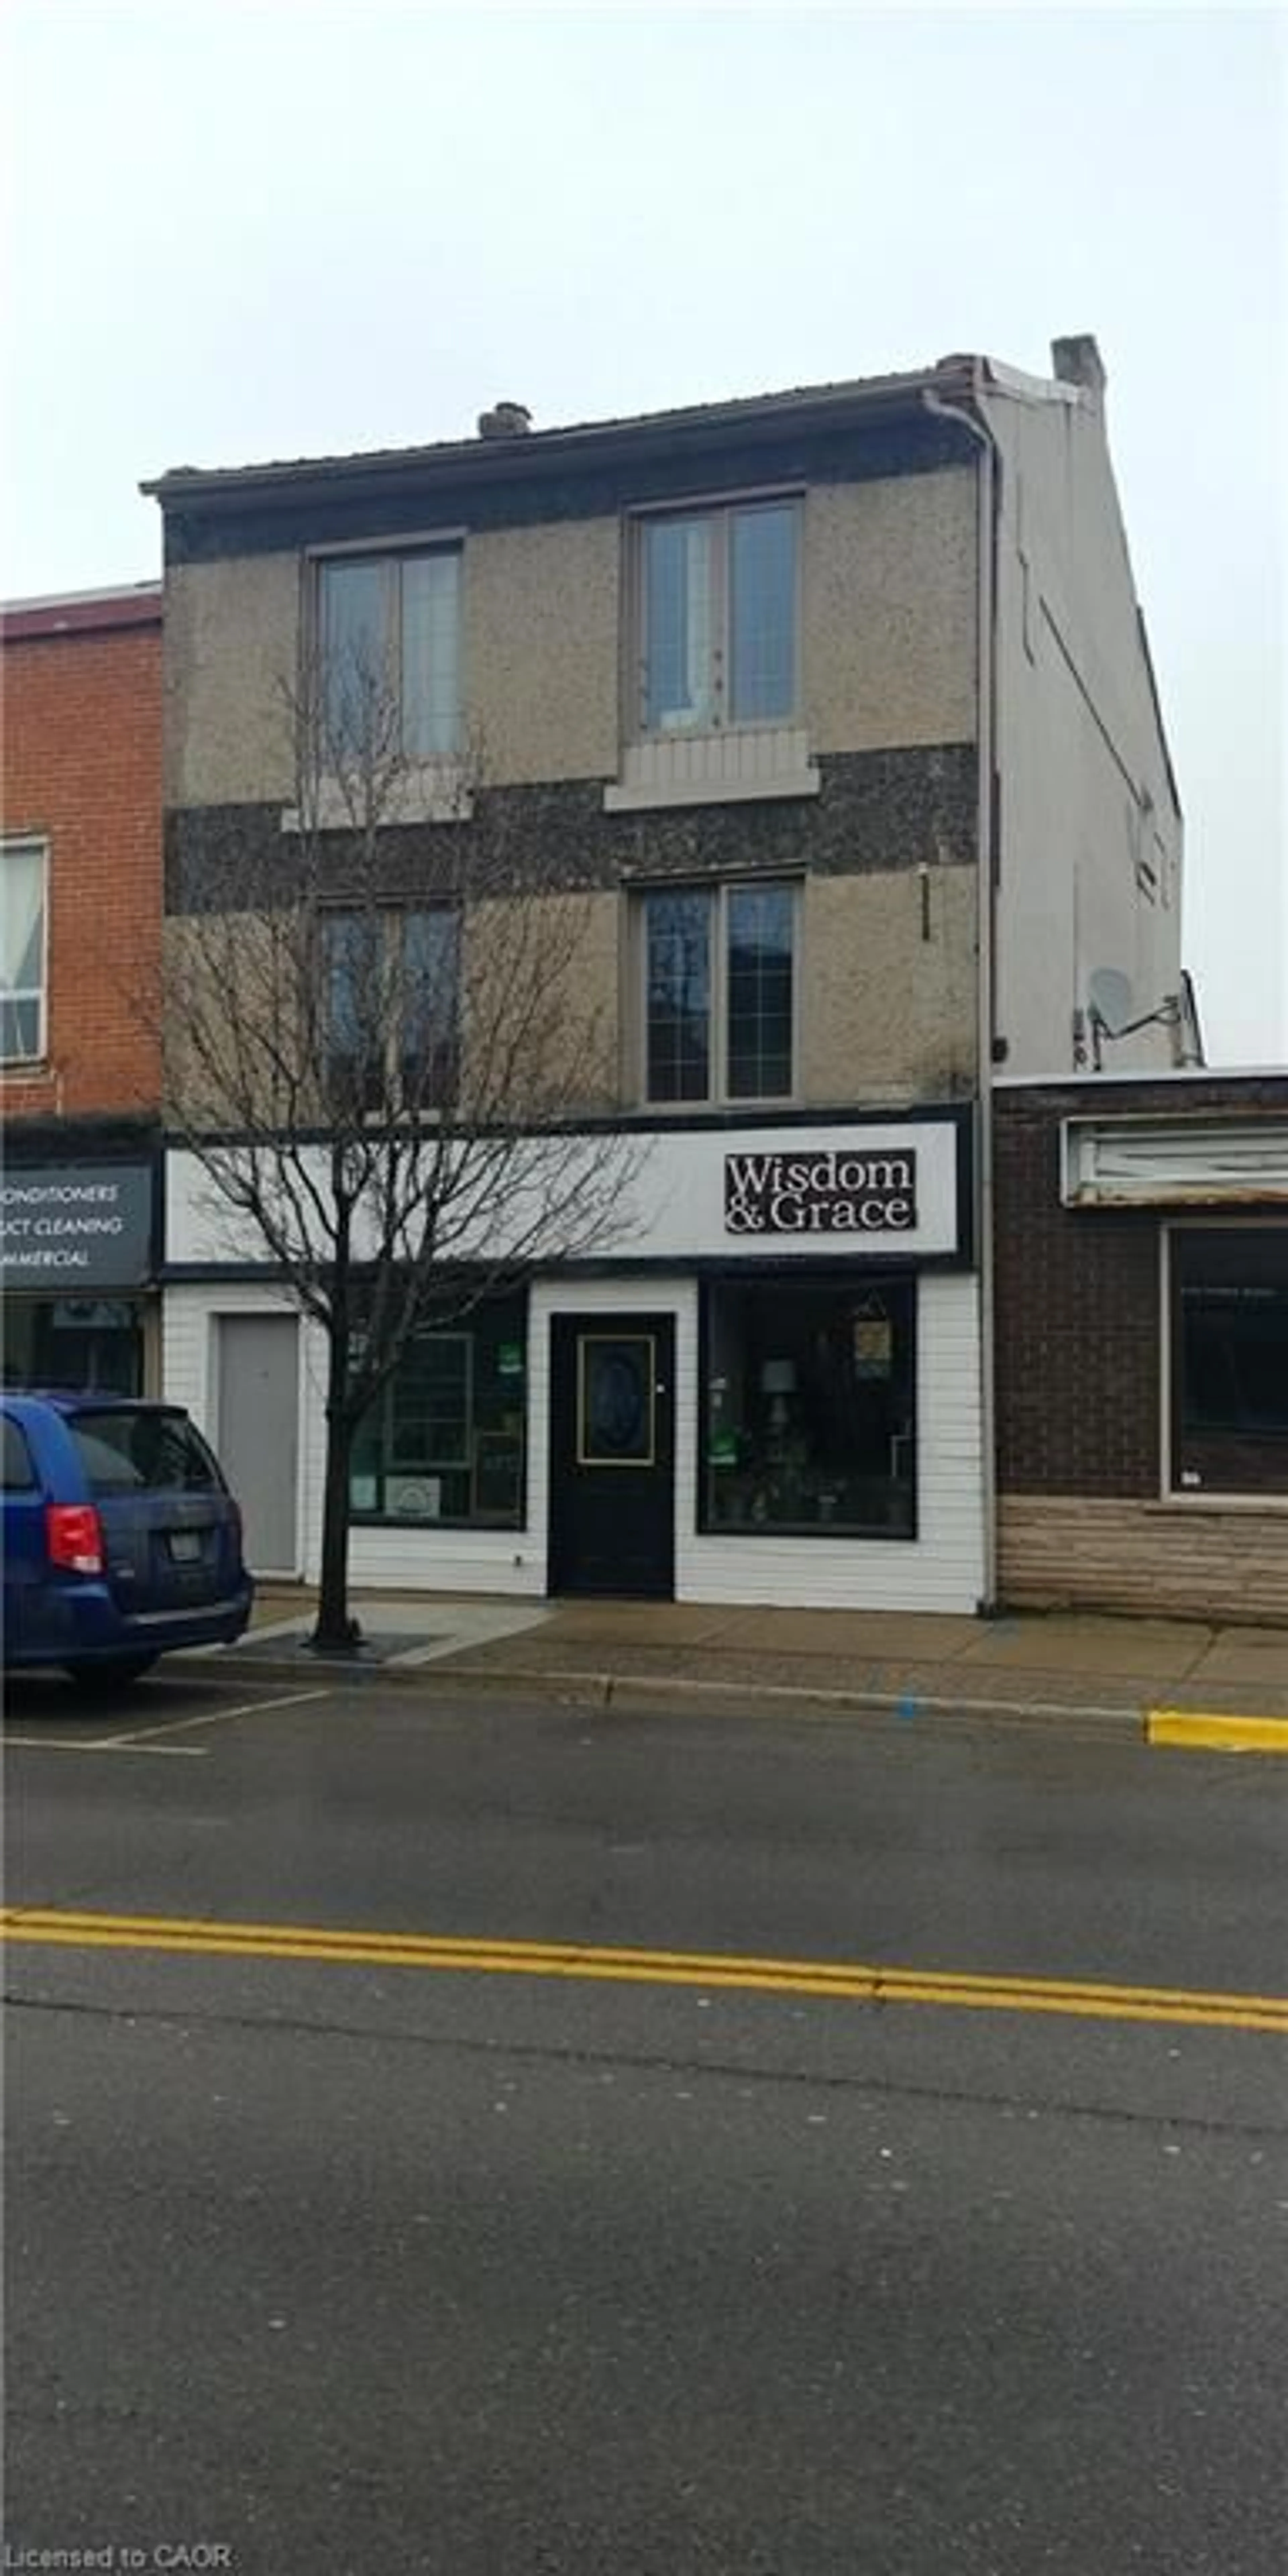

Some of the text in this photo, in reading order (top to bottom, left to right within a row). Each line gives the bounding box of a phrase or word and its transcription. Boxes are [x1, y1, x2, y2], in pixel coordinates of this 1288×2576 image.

[727, 1152, 912, 1193] Wisdom
[0, 1184, 119, 1204] ONDITIONERS
[34, 1216, 123, 1236] CLEANING
[726, 1191, 910, 1232] & Grace
